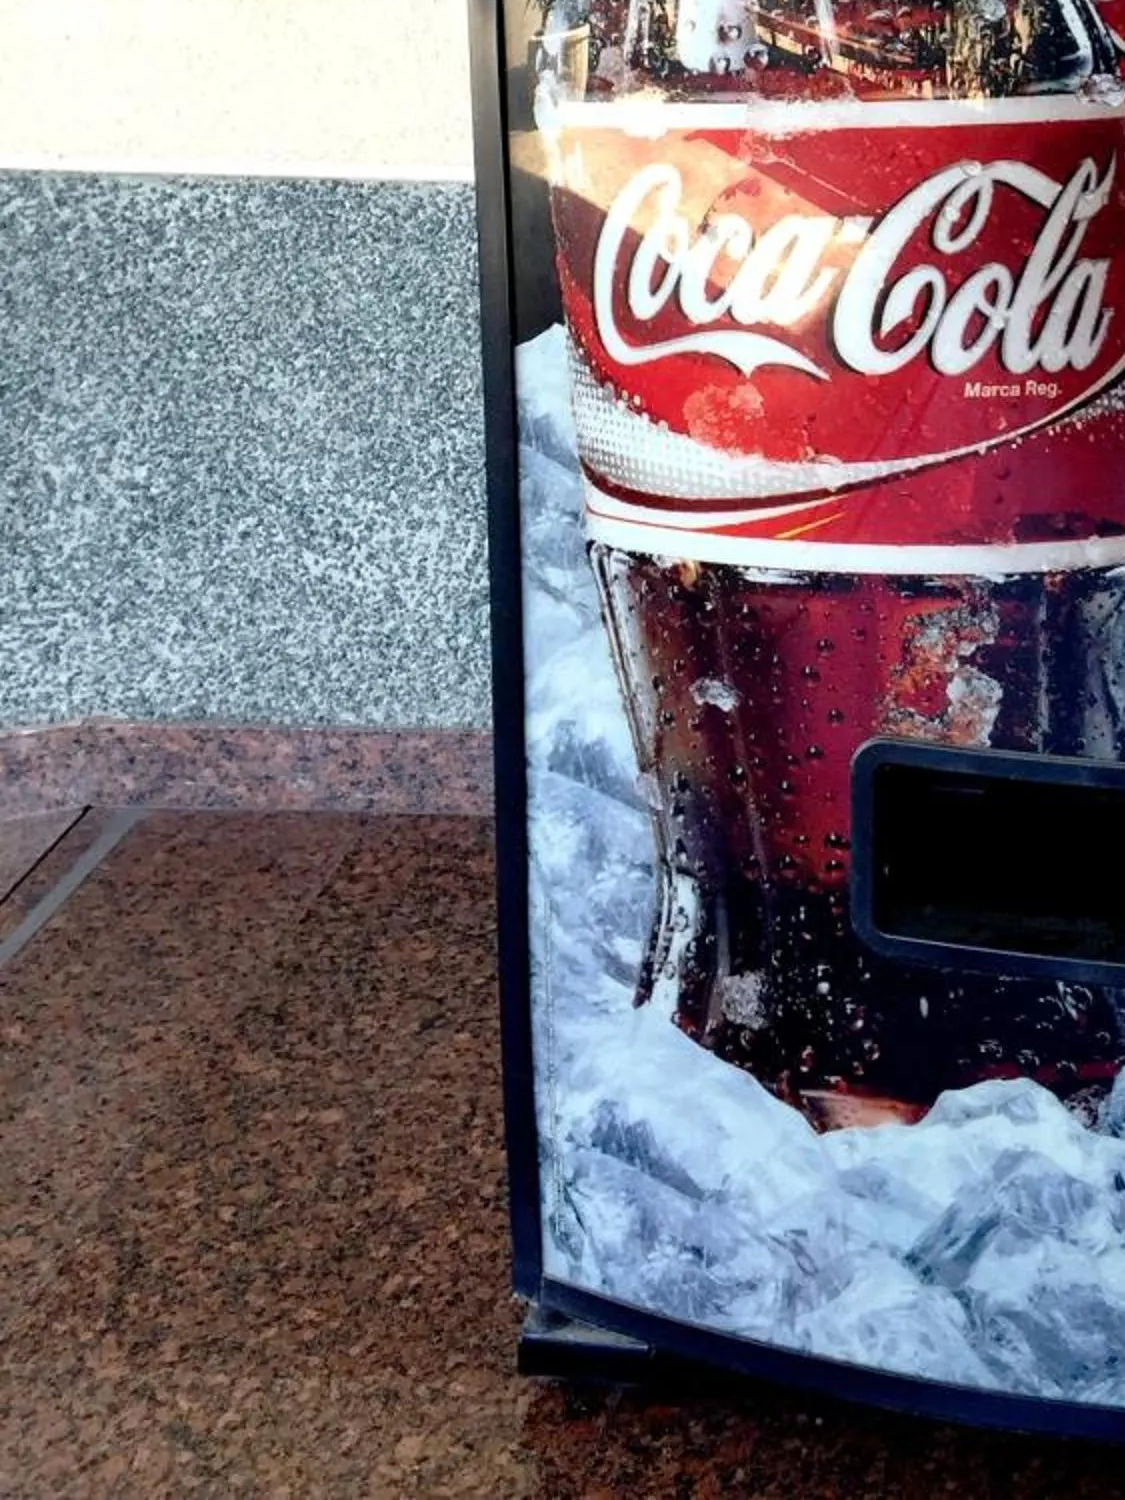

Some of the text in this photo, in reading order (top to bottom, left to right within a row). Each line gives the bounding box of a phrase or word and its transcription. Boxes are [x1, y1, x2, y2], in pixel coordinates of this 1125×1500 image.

[593, 149, 1116, 382] Coca-Cola
[963, 379, 1063, 399] Marca Reg.
